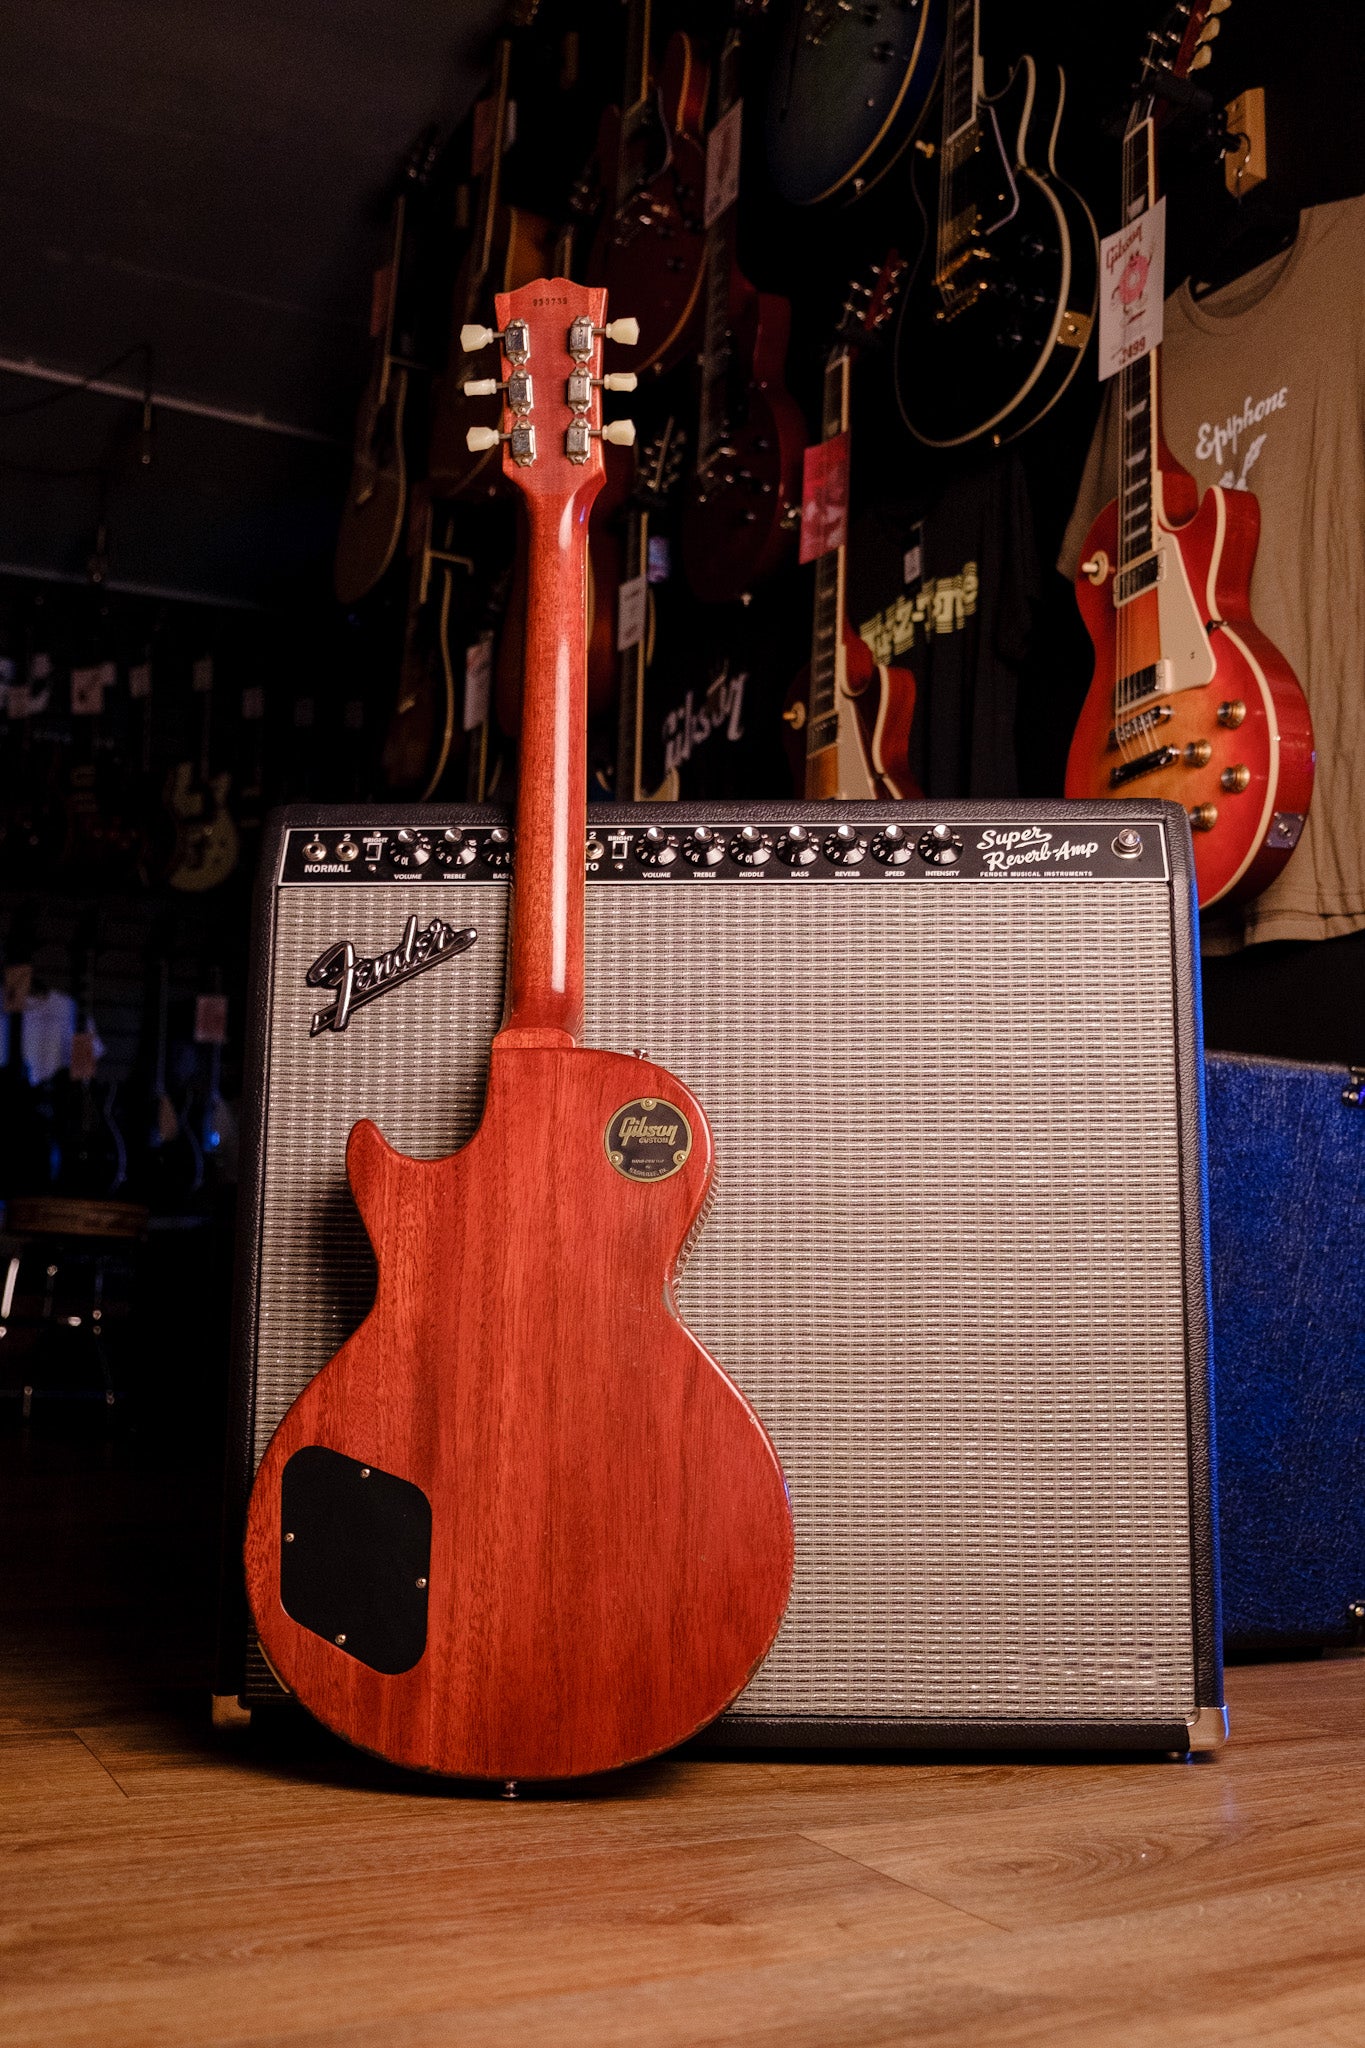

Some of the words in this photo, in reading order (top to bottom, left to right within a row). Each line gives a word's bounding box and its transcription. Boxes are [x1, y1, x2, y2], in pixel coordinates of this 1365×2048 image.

[1195, 386, 1289, 466] Epiphone
[313, 833, 320, 842] 1
[342, 833, 352, 842] 2
[588, 831, 597, 840] 2
[976, 826, 1053, 851] Super
[303, 864, 352, 873] NORMAL
[585, 862, 600, 871] TO
[982, 841, 1099, 872] Reverb-Amp
[306, 914, 478, 1037] Fender
[618, 1116, 679, 1147] Gibson
